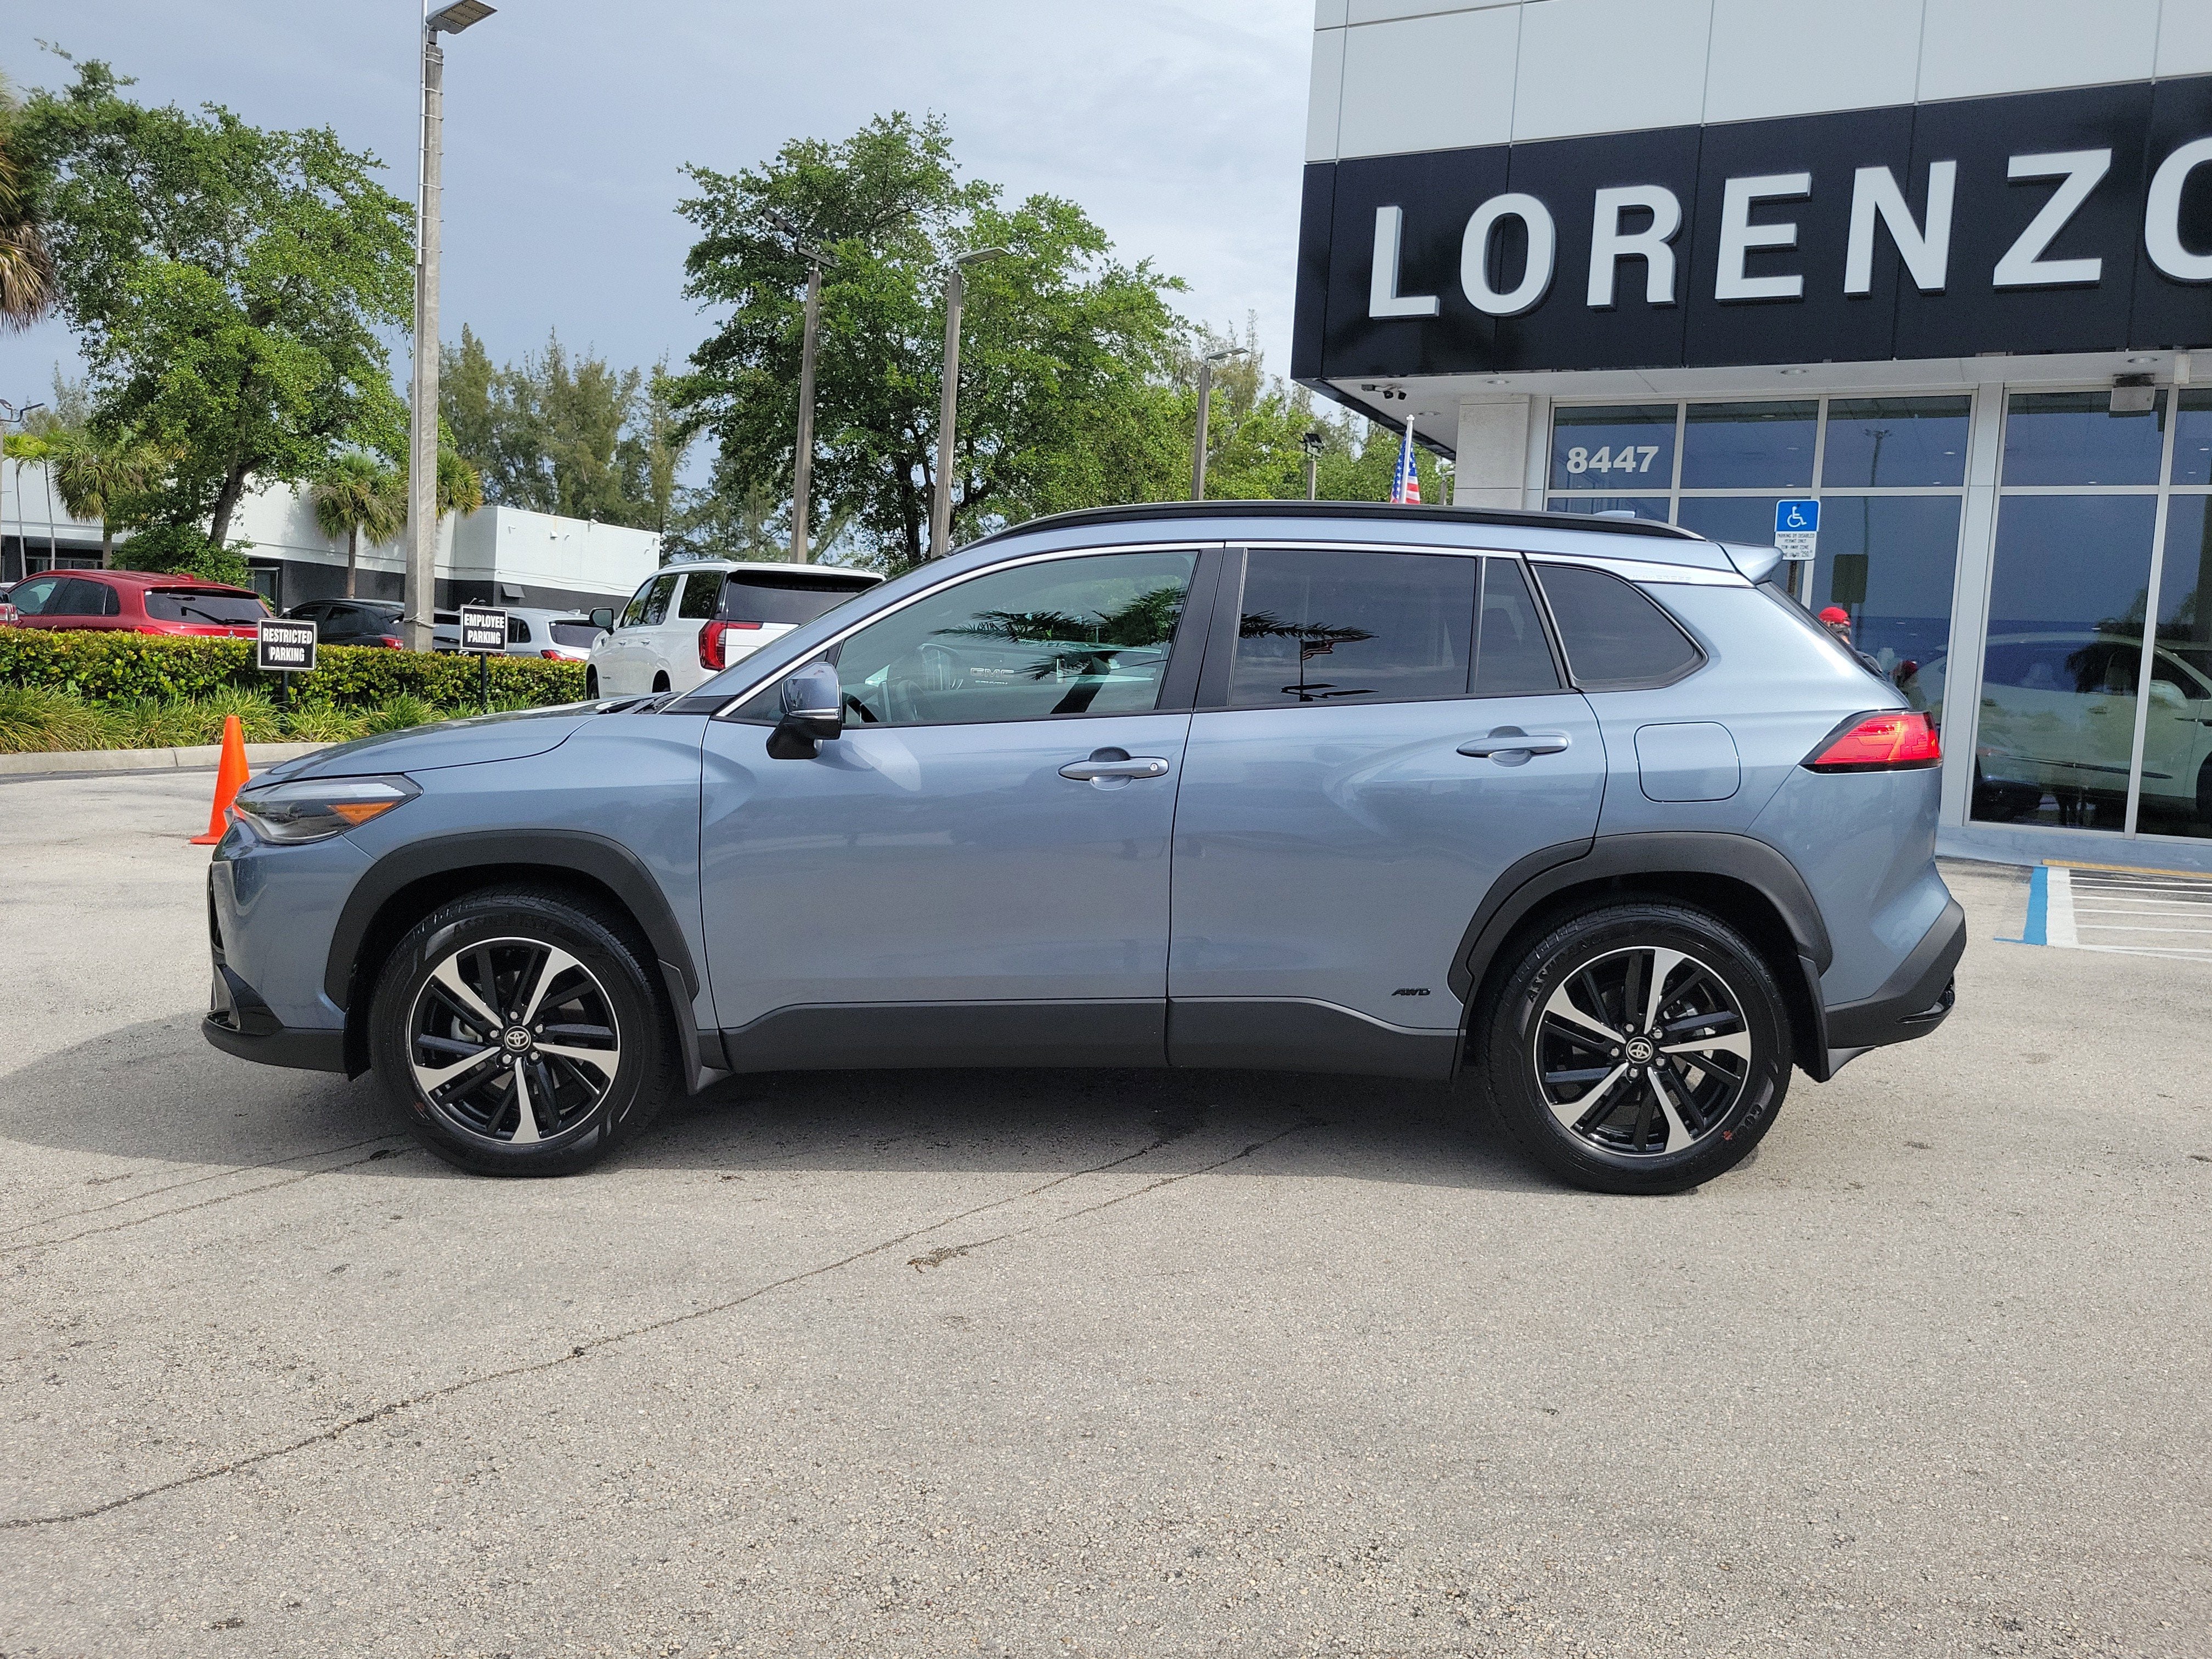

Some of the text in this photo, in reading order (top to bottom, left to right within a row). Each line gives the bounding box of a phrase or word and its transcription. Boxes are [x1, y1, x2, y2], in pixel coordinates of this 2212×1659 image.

[1566, 446, 1658, 473] 8447
[464, 613, 505, 629] EMPLOYEE
[263, 628, 313, 644] RESTRICTED
[467, 630, 501, 644] PARKING
[269, 646, 305, 662] PARKING
[970, 668, 1014, 678] GMC
[1391, 988, 1431, 996] AWD
